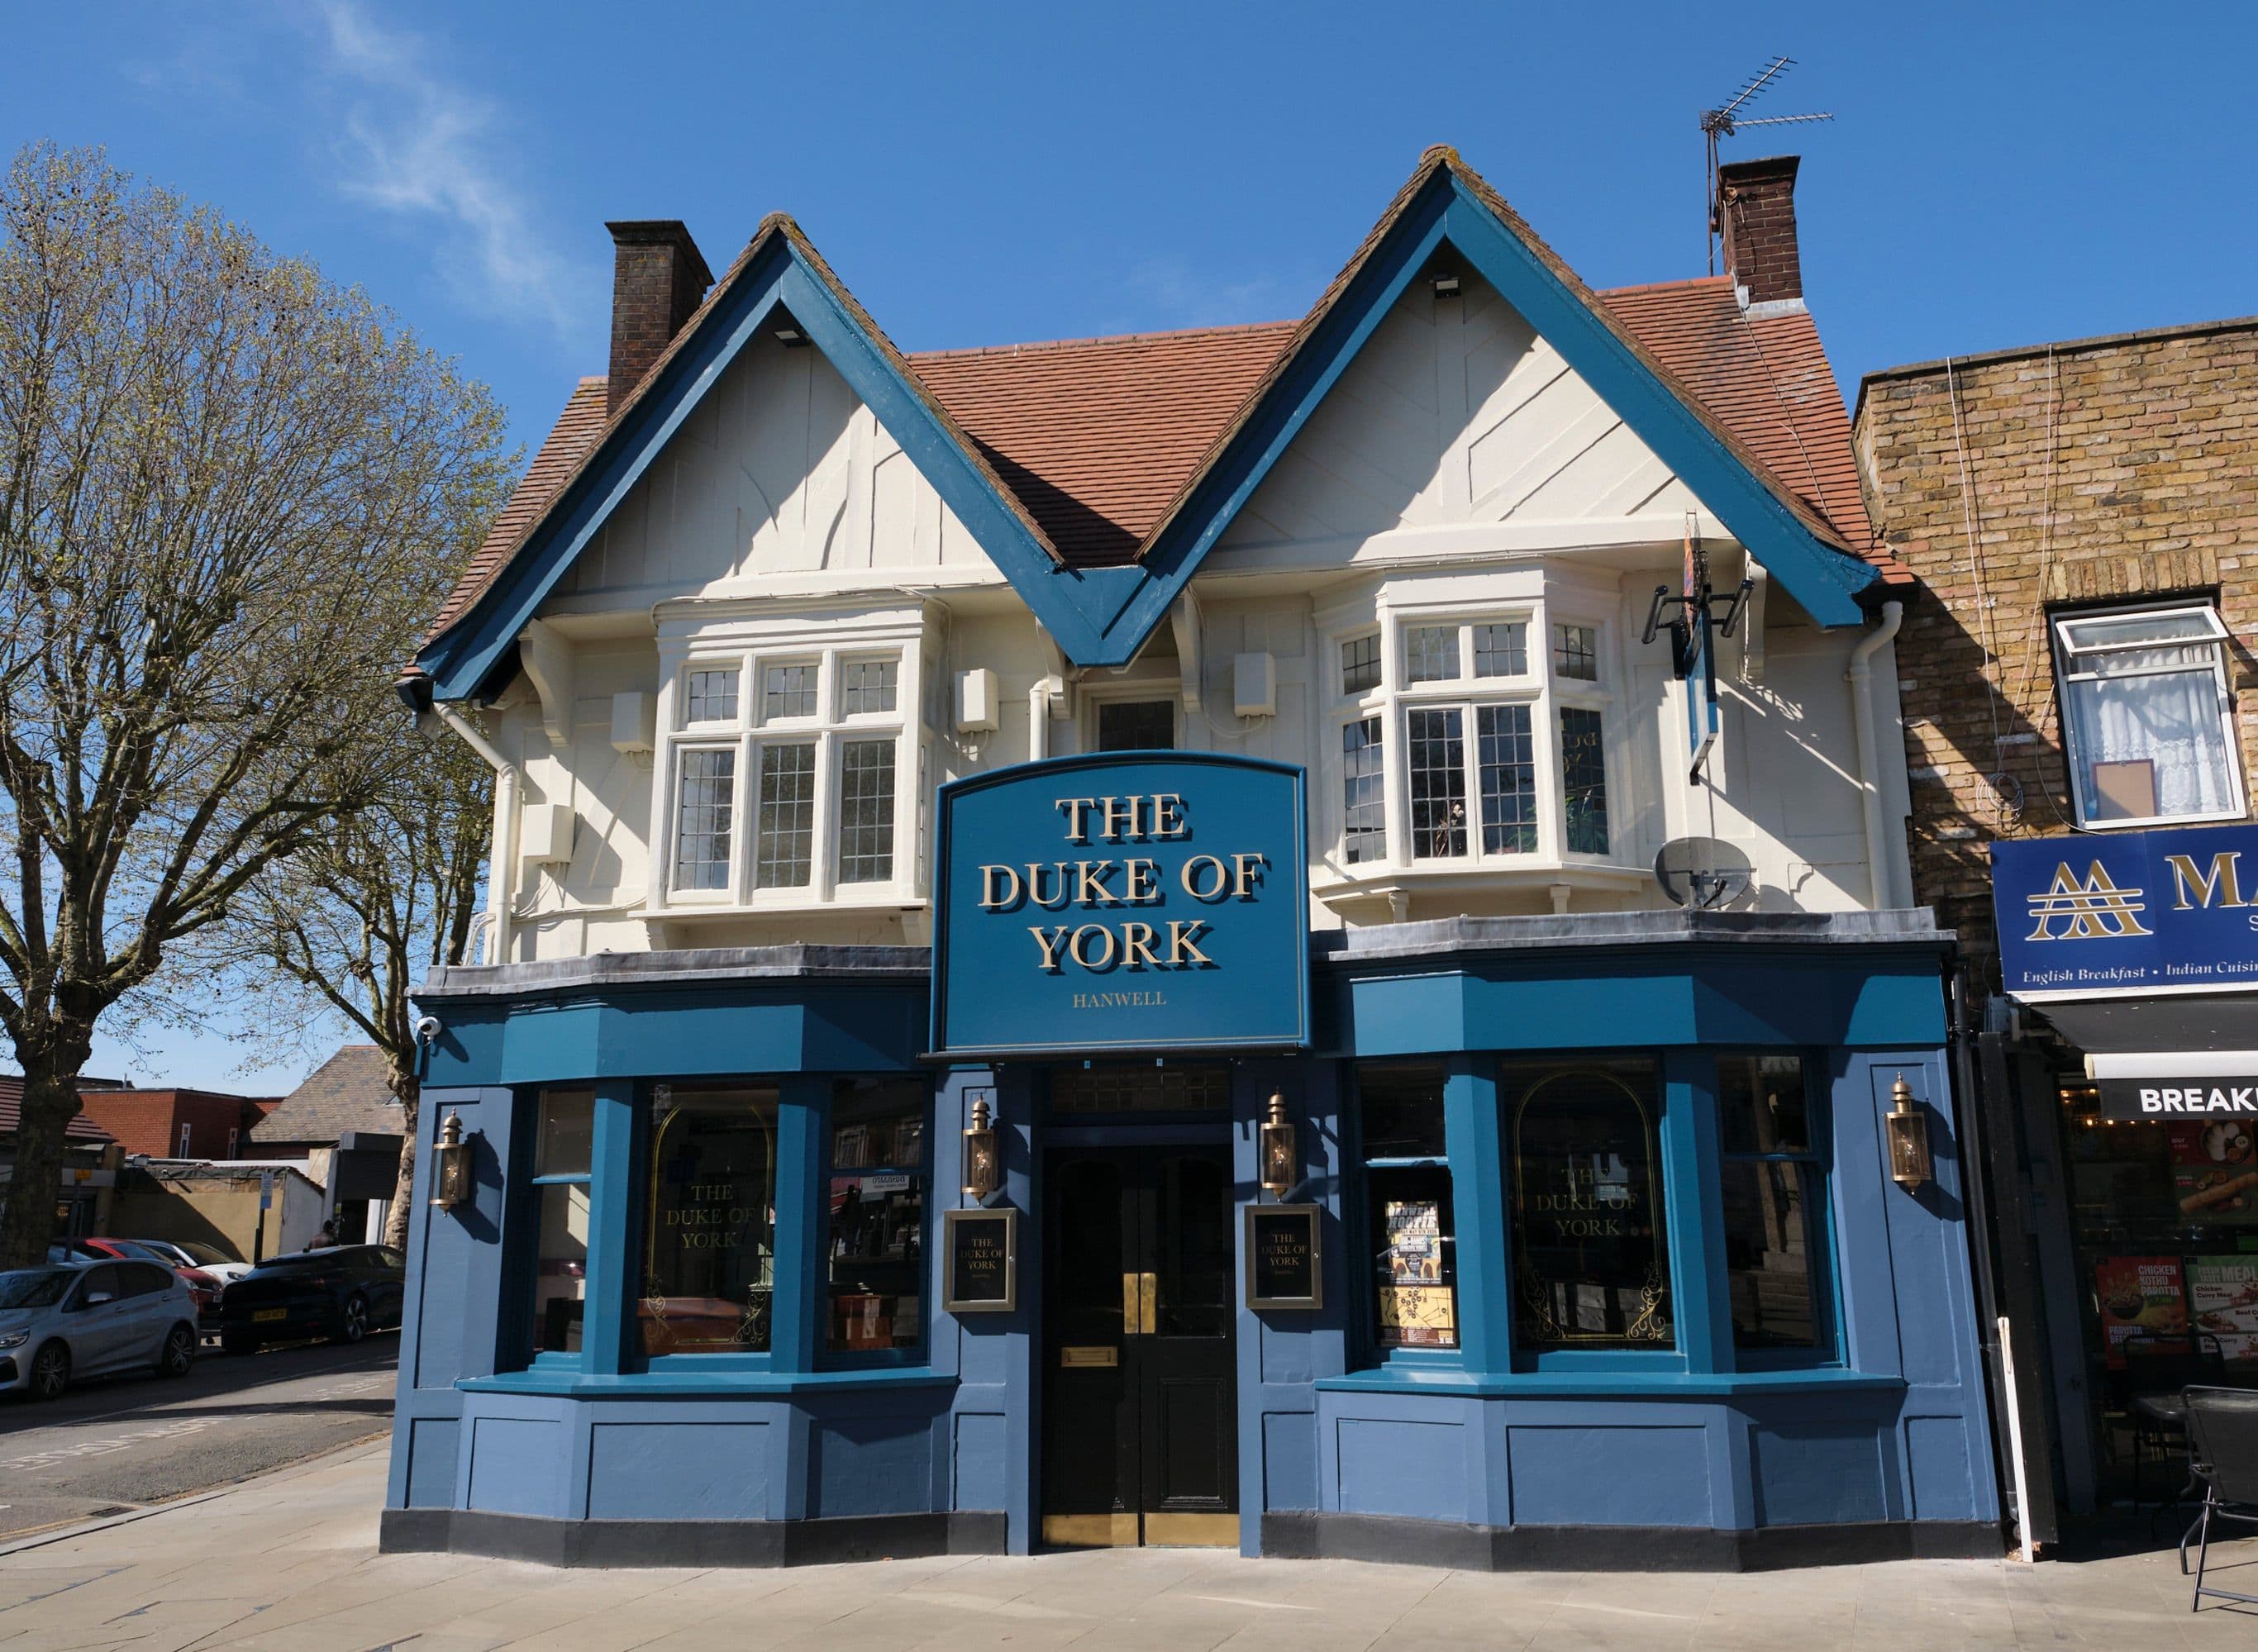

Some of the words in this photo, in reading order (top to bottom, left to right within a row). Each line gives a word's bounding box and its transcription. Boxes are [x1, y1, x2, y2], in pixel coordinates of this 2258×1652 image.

[1055, 793, 1184, 840] THE
[977, 859, 1157, 907] DUKE
[1181, 853, 1265, 897] OF
[2165, 852, 2258, 910] M
[1028, 920, 1212, 969] YORK
[2023, 970, 2074, 985] English
[2078, 967, 2145, 982] Breakfast
[2166, 963, 2212, 976] Indian
[1071, 991, 1167, 1008] HANWELL
[2139, 1088, 2258, 1112] BREAK
[690, 1183, 734, 1201] THE
[667, 1208, 722, 1225] DUKE
[728, 1207, 755, 1224] OF
[1388, 1206, 1436, 1216] HANWELL
[1388, 1216, 1436, 1229] HOOTIE
[1554, 1219, 1623, 1236] YORK
[682, 1231, 739, 1248] YORK
[972, 1238, 993, 1247] THE
[1272, 1234, 1295, 1243] THE
[960, 1249, 989, 1258] DUKE
[991, 1249, 1005, 1258] OF
[1293, 1245, 1308, 1254] OF
[967, 1261, 997, 1269] YORK
[1269, 1256, 1299, 1266] YORK
[2138, 1264, 2176, 1276] CHICKEN
[2139, 1275, 2169, 1286] KOTHU
[2141, 1285, 2180, 1297] PAROTTA
[2108, 1325, 2142, 1335] PAROTTA
